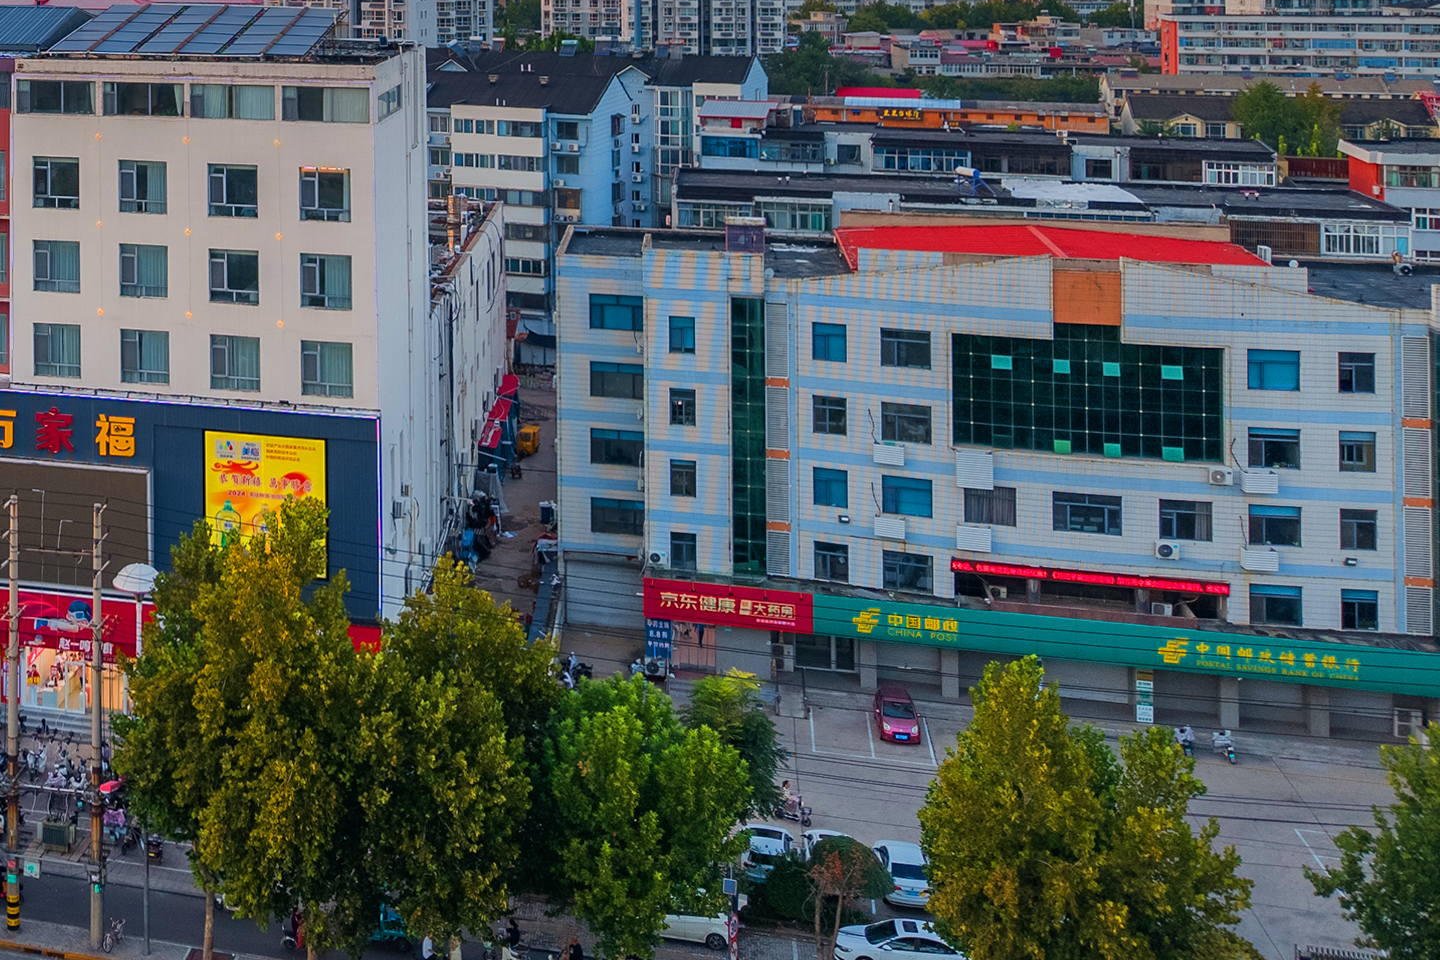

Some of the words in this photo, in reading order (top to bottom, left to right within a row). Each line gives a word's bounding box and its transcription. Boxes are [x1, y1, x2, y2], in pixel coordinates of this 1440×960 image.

[659, 591, 736, 614] 京东健康
[753, 602, 794, 619] 大药房
[887, 612, 959, 633] 中国邮政
[649, 630, 668, 639] 8.8折
[887, 627, 922, 638] CHINA
[930, 632, 958, 642] POST
[59, 637, 113, 655] 赵一鸣食
[1196, 642, 1360, 673] 中国邮政储蓄银行
[1196, 660, 1232, 670] POSTAL
[1236, 663, 1277, 674] SAVINGS
[1282, 668, 1308, 677] BANK
